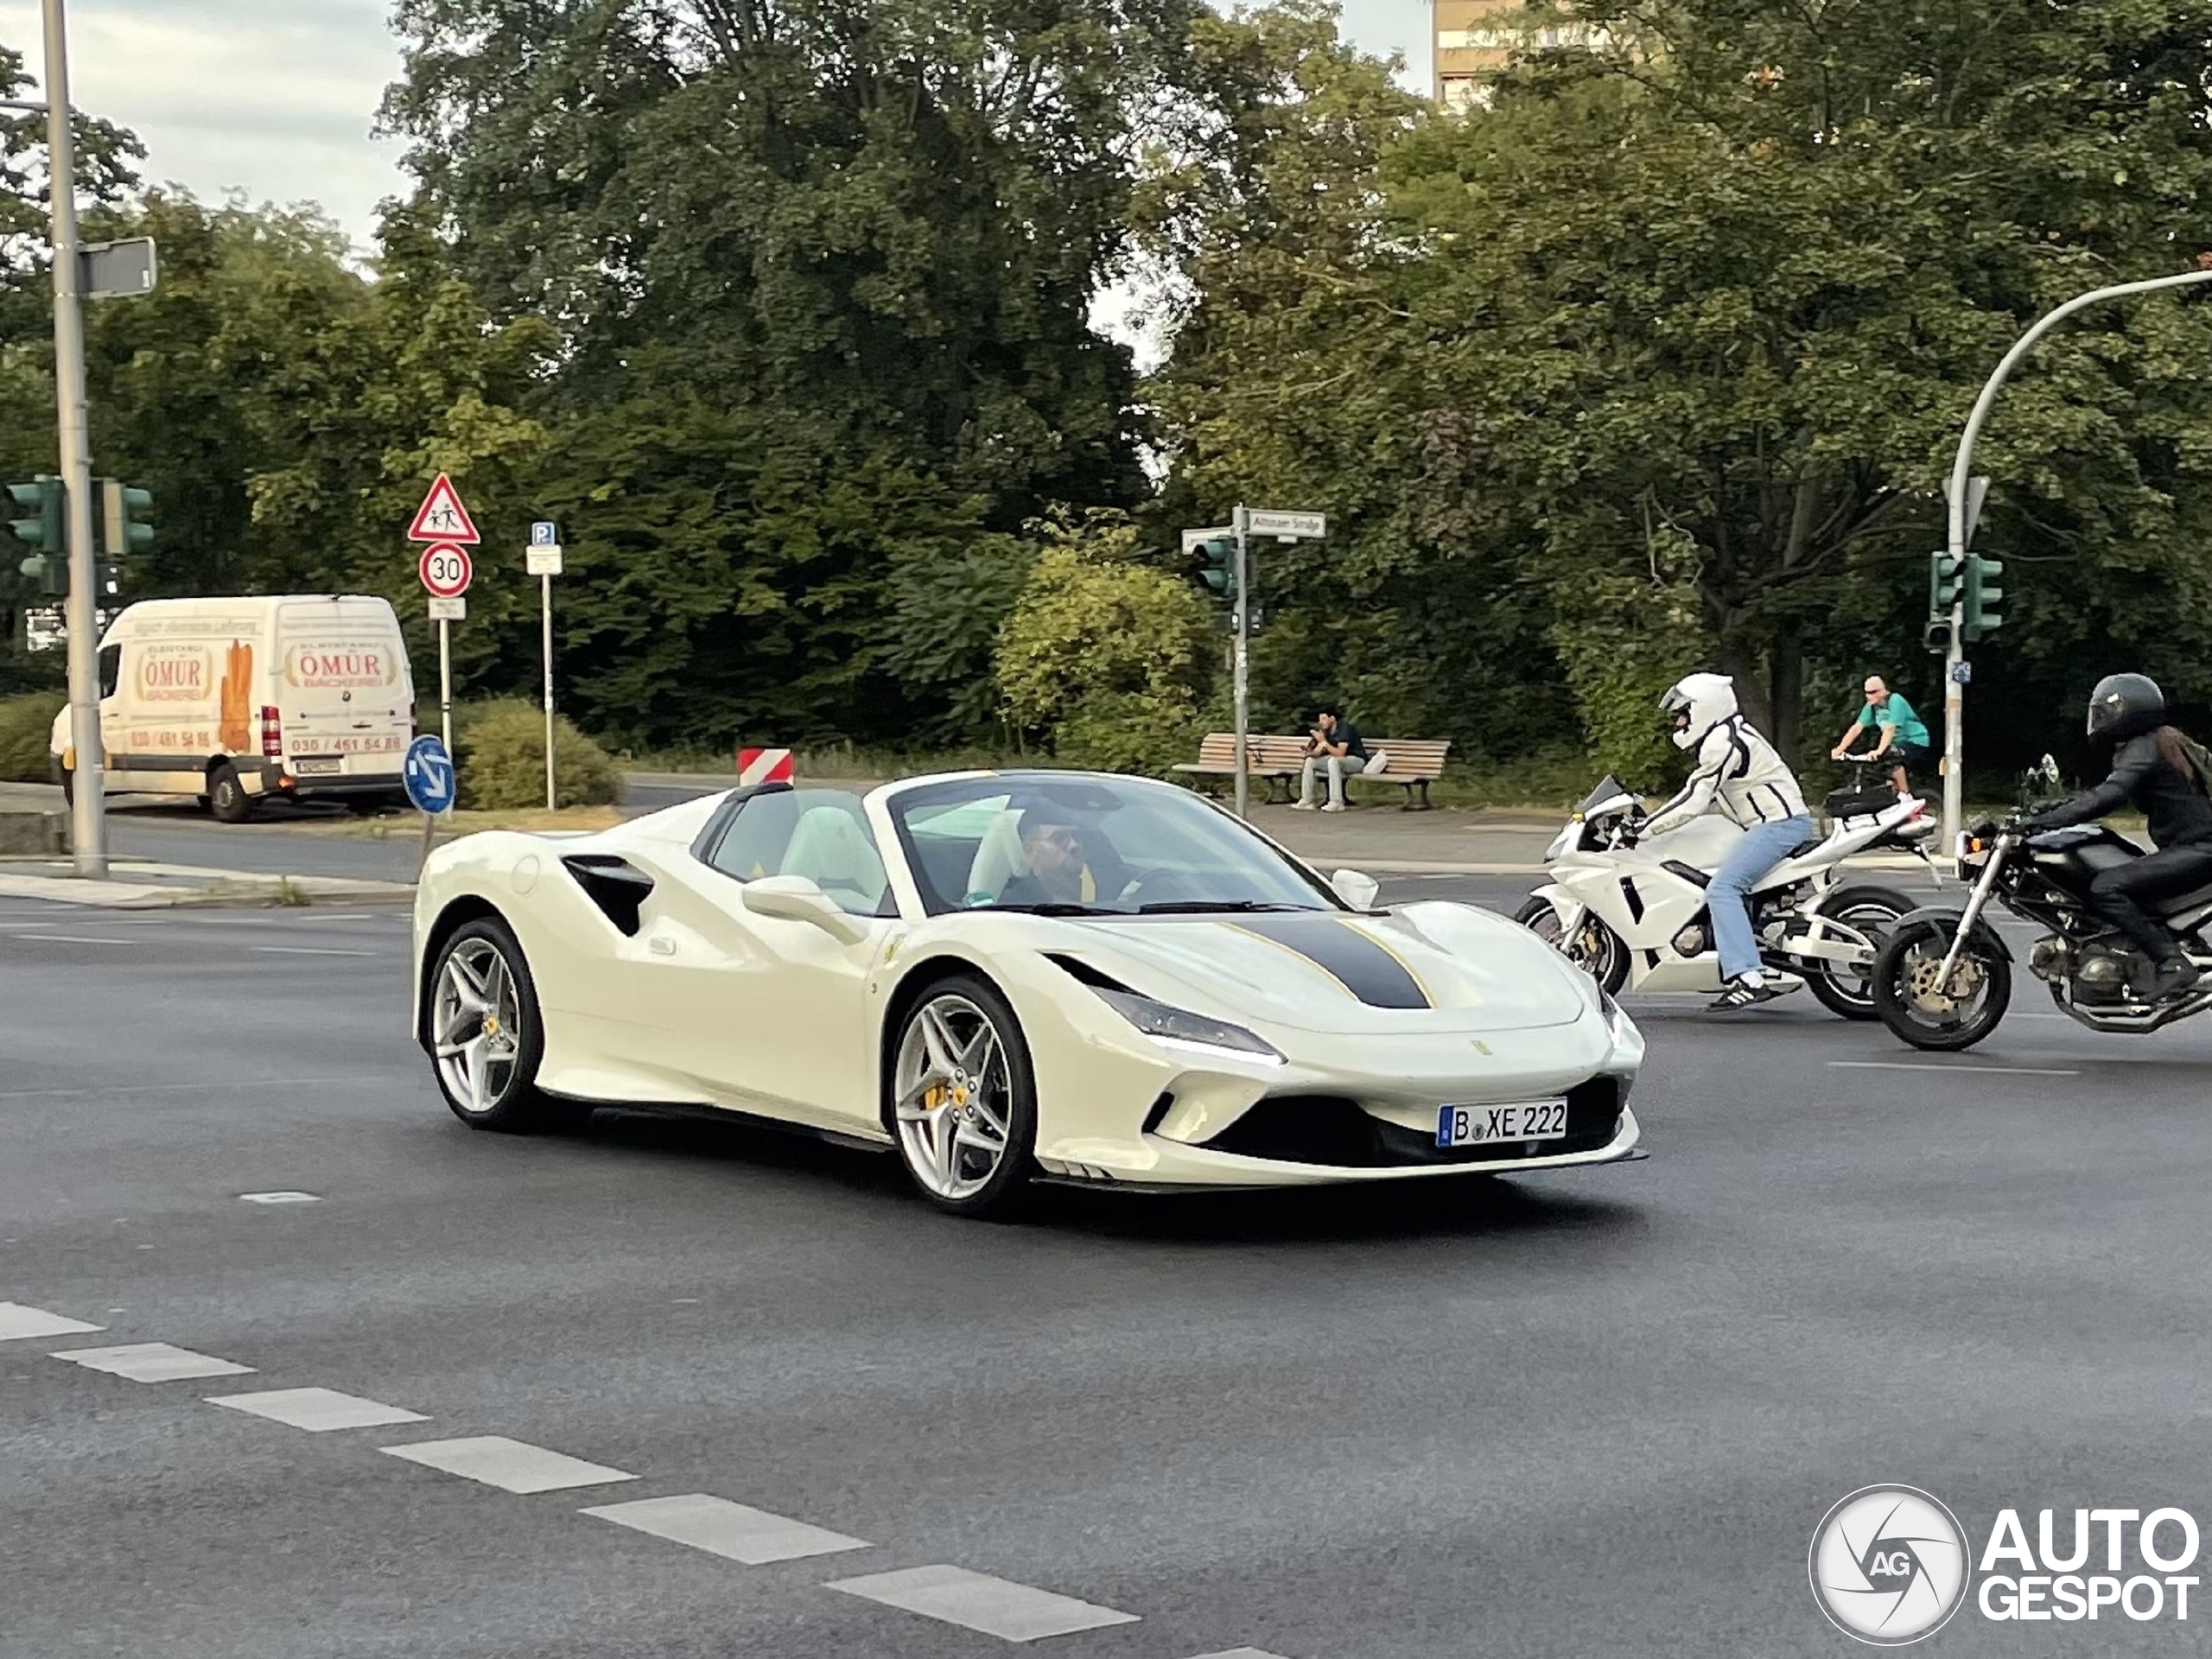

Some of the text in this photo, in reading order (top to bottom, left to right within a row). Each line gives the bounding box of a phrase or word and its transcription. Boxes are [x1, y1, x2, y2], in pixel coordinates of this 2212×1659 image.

[433, 556, 460, 581] 30
[291, 739, 319, 752] 030
[1454, 1104, 1565, 1141] B XE 222
